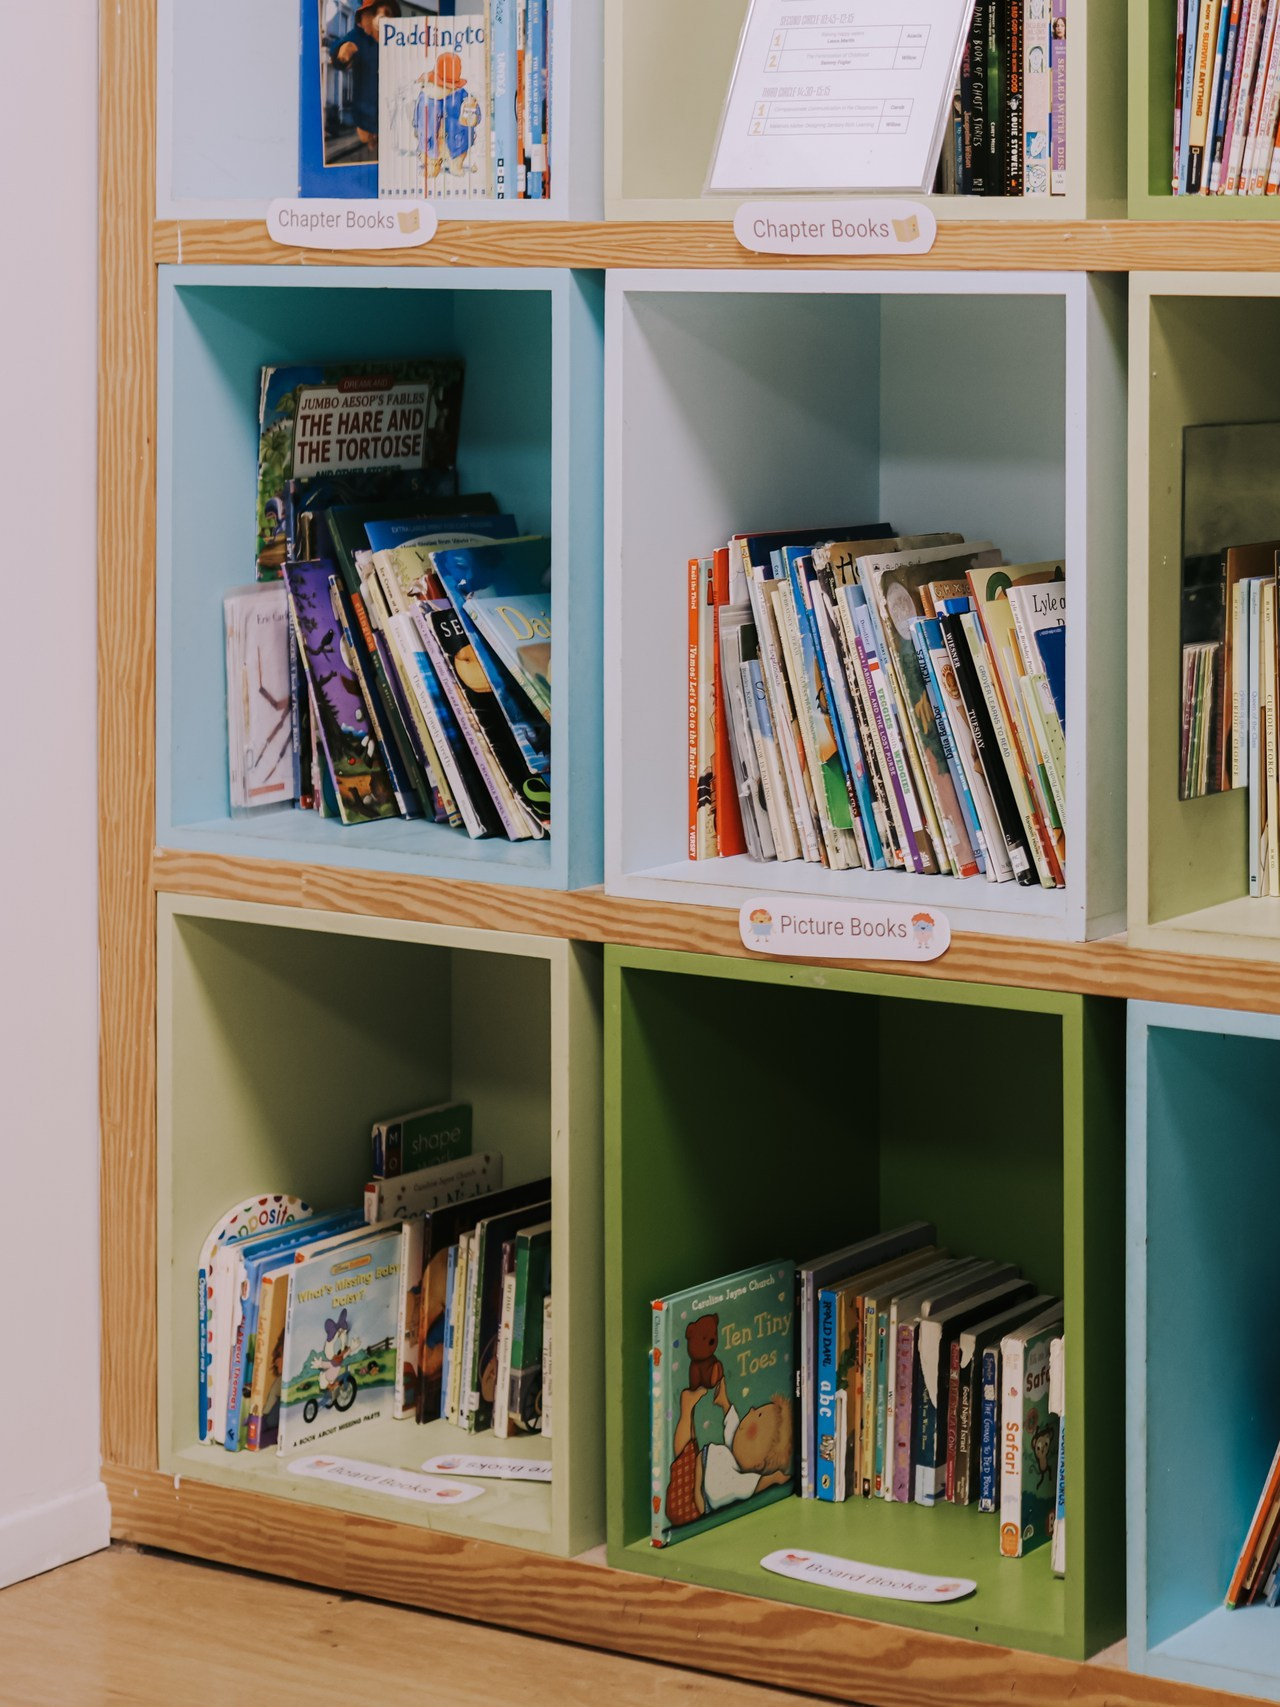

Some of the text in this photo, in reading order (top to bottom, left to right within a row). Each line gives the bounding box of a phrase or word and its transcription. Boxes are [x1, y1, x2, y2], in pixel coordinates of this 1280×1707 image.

[974, 40, 982, 61] BOOK
[975, 68, 983, 78] OF
[973, 83, 983, 111] GHOST
[973, 118, 983, 146] STORIES
[278, 210, 394, 231] Chapter Books
[753, 219, 889, 242] Chapter Books
[302, 392, 425, 410] JUMBO AESOP'S FABLES
[300, 408, 424, 438] THE HARE AND
[297, 434, 422, 464] THE TORTOISE
[1033, 592, 1057, 616] Lyle
[689, 644, 697, 679] ¡Vamos!
[945, 632, 961, 668] WIESNER
[689, 704, 696, 717] Go
[689, 719, 696, 729] to
[863, 668, 895, 776] ABIGAIL AND THE LOST PURSE
[980, 665, 1010, 758] GROVER LEARNS TO READ
[878, 688, 895, 729] VEGGIES
[892, 750, 910, 794] WEDGIES
[967, 709, 985, 749] TUESDAY
[781, 916, 908, 938] Picture Books
[412, 1126, 461, 1154] shape
[332, 1288, 366, 1311] Daisy?
[690, 1275, 775, 1312] Caroline Jayne Church
[722, 1310, 792, 1350] Ten Tiny
[823, 1301, 833, 1367] ROALD DAHL
[230, 1330, 243, 1410] About Thomas
[736, 1346, 778, 1377] Toes
[819, 1380, 834, 1418] abc
[299, 1434, 316, 1445] BOOK
[318, 1427, 337, 1441] ABOUT
[338, 1418, 365, 1434] MISSING
[366, 1411, 381, 1426] PARTS
[983, 1419, 991, 1442] GOING
[1005, 1422, 1019, 1475] Safari
[806, 1562, 928, 1594] Board Books
